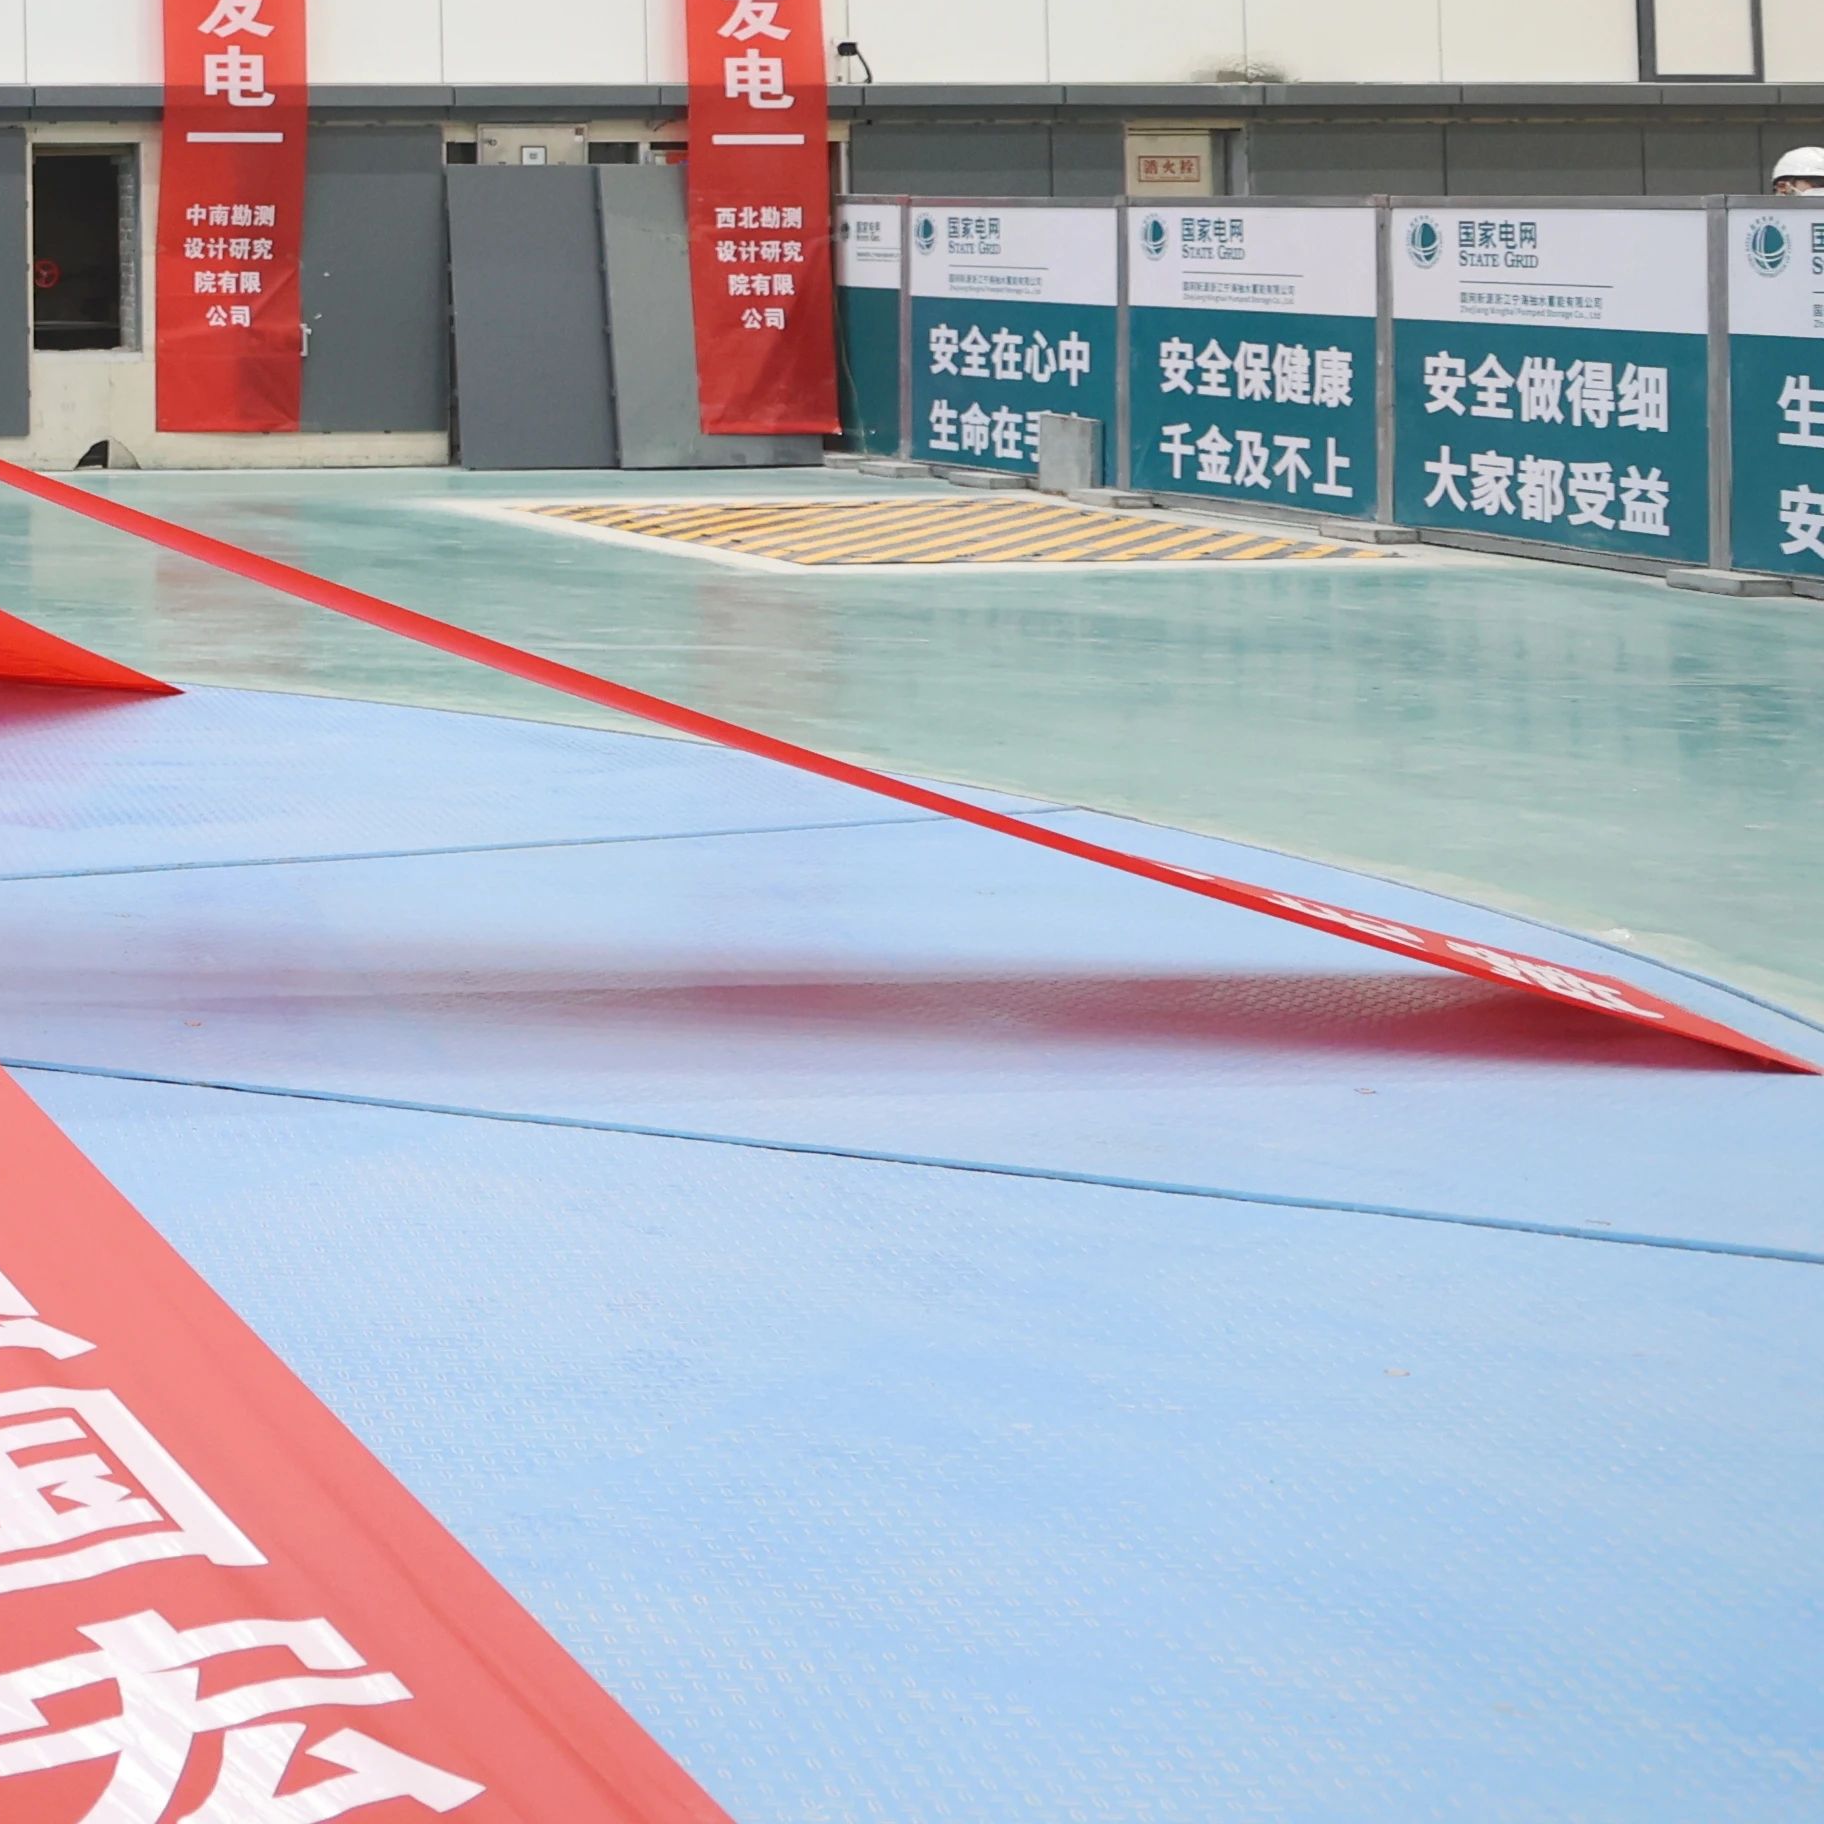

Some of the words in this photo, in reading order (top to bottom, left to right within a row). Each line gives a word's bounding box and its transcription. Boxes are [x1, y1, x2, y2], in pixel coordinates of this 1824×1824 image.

[186, 204, 275, 226] 中南勘测
[715, 207, 802, 229] 西北勘测
[948, 217, 1000, 240] 国家电网
[1181, 218, 1244, 243] 国家电网
[1458, 220, 1538, 249] 国家电网
[184, 238, 273, 260] 设计研究
[715, 240, 804, 263] 设计研究
[1181, 244, 1213, 260] STATE
[1217, 244, 1245, 261] GRID
[1458, 250, 1499, 268] STATE
[1504, 251, 1539, 269] GRID
[195, 271, 261, 293] 院有限
[728, 274, 795, 296] 院有限
[207, 306, 251, 327] 公司
[742, 308, 785, 330] 公司
[929, 323, 1090, 386] 安全在心中
[1160, 337, 1353, 408] 安全保健康
[1424, 350, 1669, 433] 安全做得细
[1160, 423, 1353, 498] 千金及不上
[1424, 445, 1670, 537] 大家都受益
